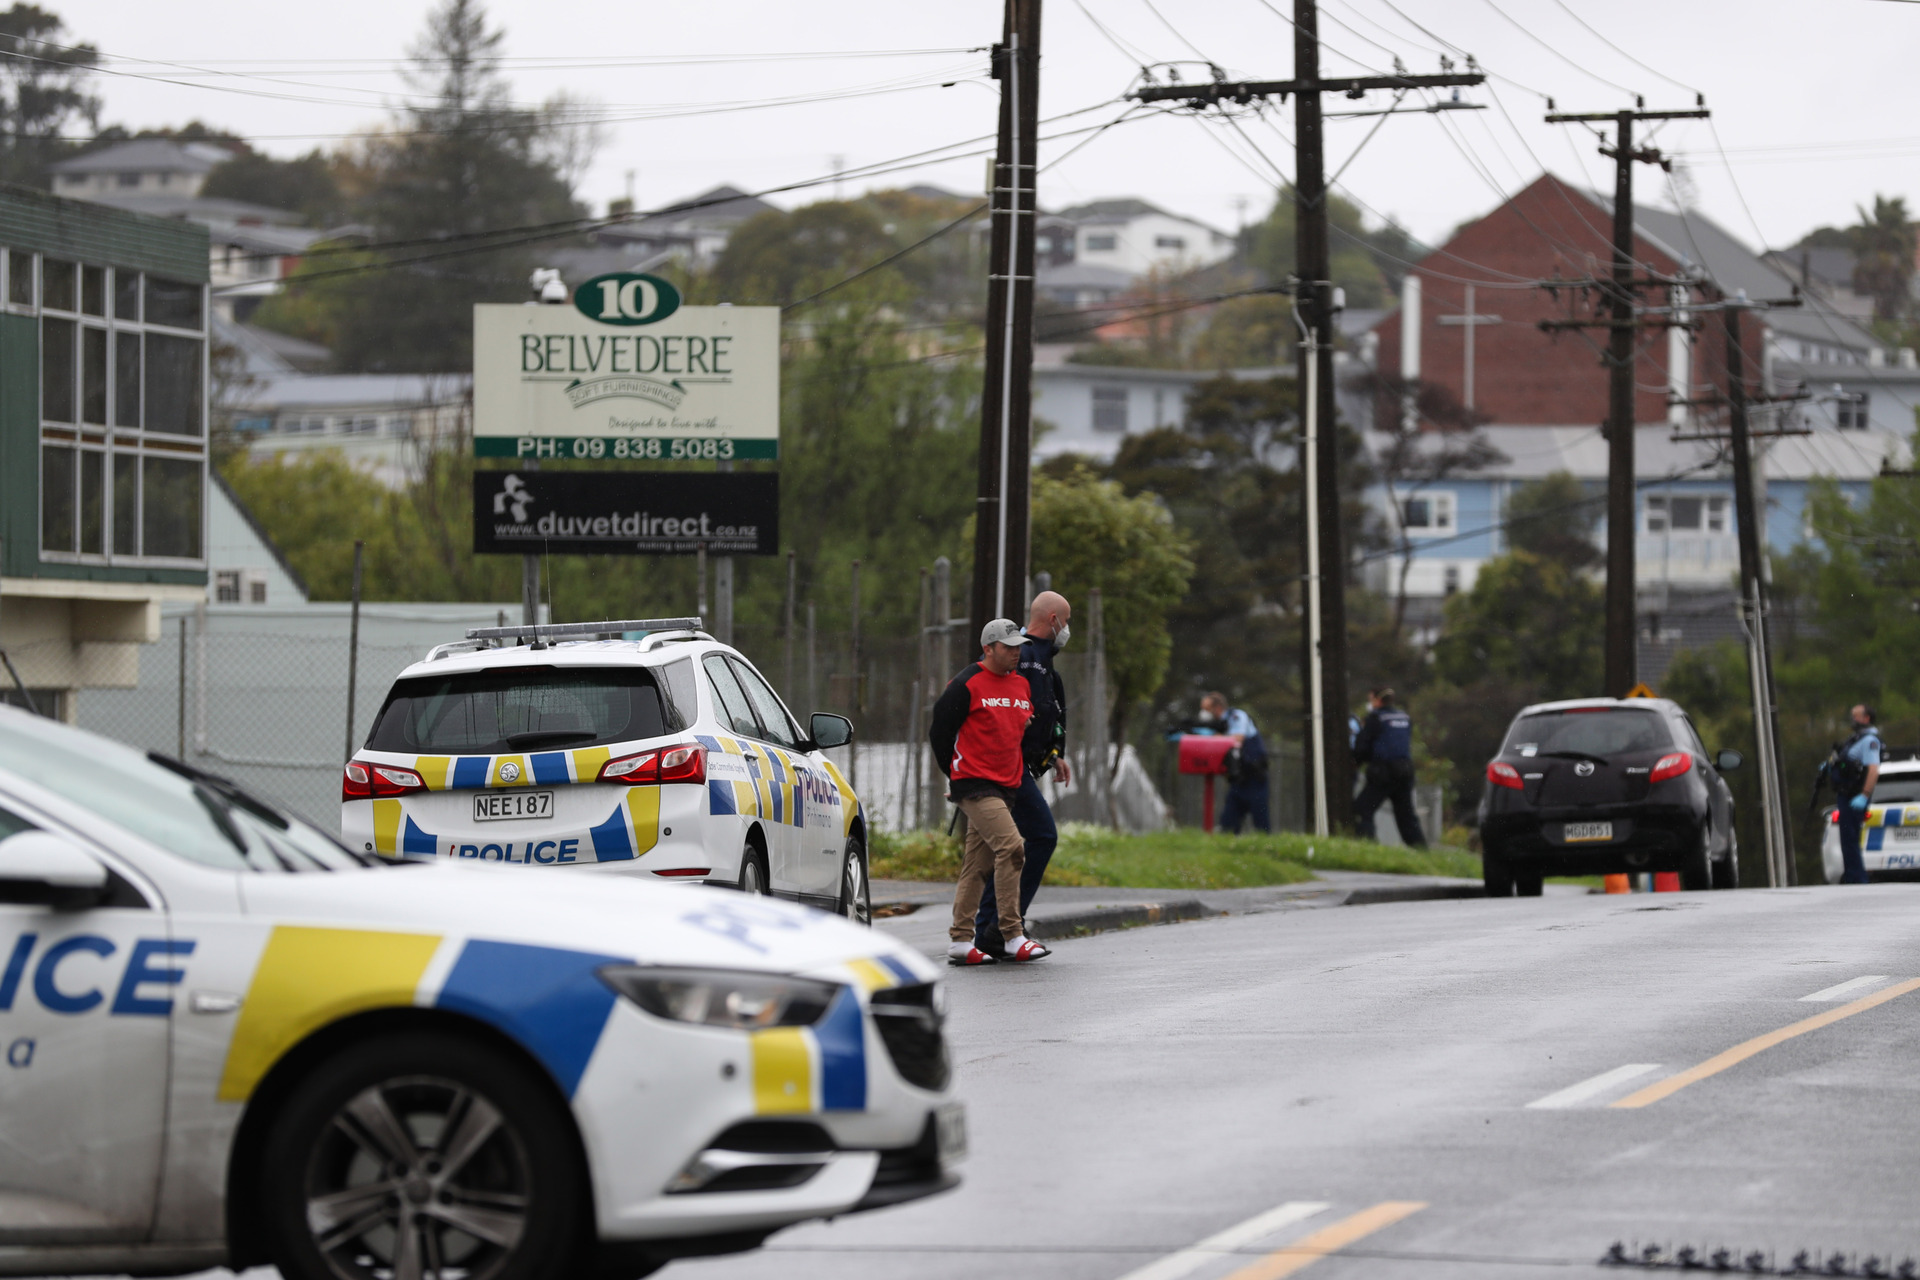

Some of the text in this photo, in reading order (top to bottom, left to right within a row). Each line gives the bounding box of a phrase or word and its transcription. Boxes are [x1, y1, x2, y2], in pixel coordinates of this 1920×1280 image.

[597, 279, 658, 319] 10
[520, 334, 733, 373] BELVEDERE
[571, 384, 600, 402] SOFT
[608, 416, 653, 432] Designed
[657, 418, 667, 428] to
[517, 438, 735, 459] PH: 09 838 5083
[493, 510, 757, 537] www.duvetdirect.co.nz
[982, 698, 1031, 711] NIKE AIR
[804, 769, 840, 806] POLICE
[477, 794, 549, 817] NEE187
[1566, 824, 1610, 838] MGD851
